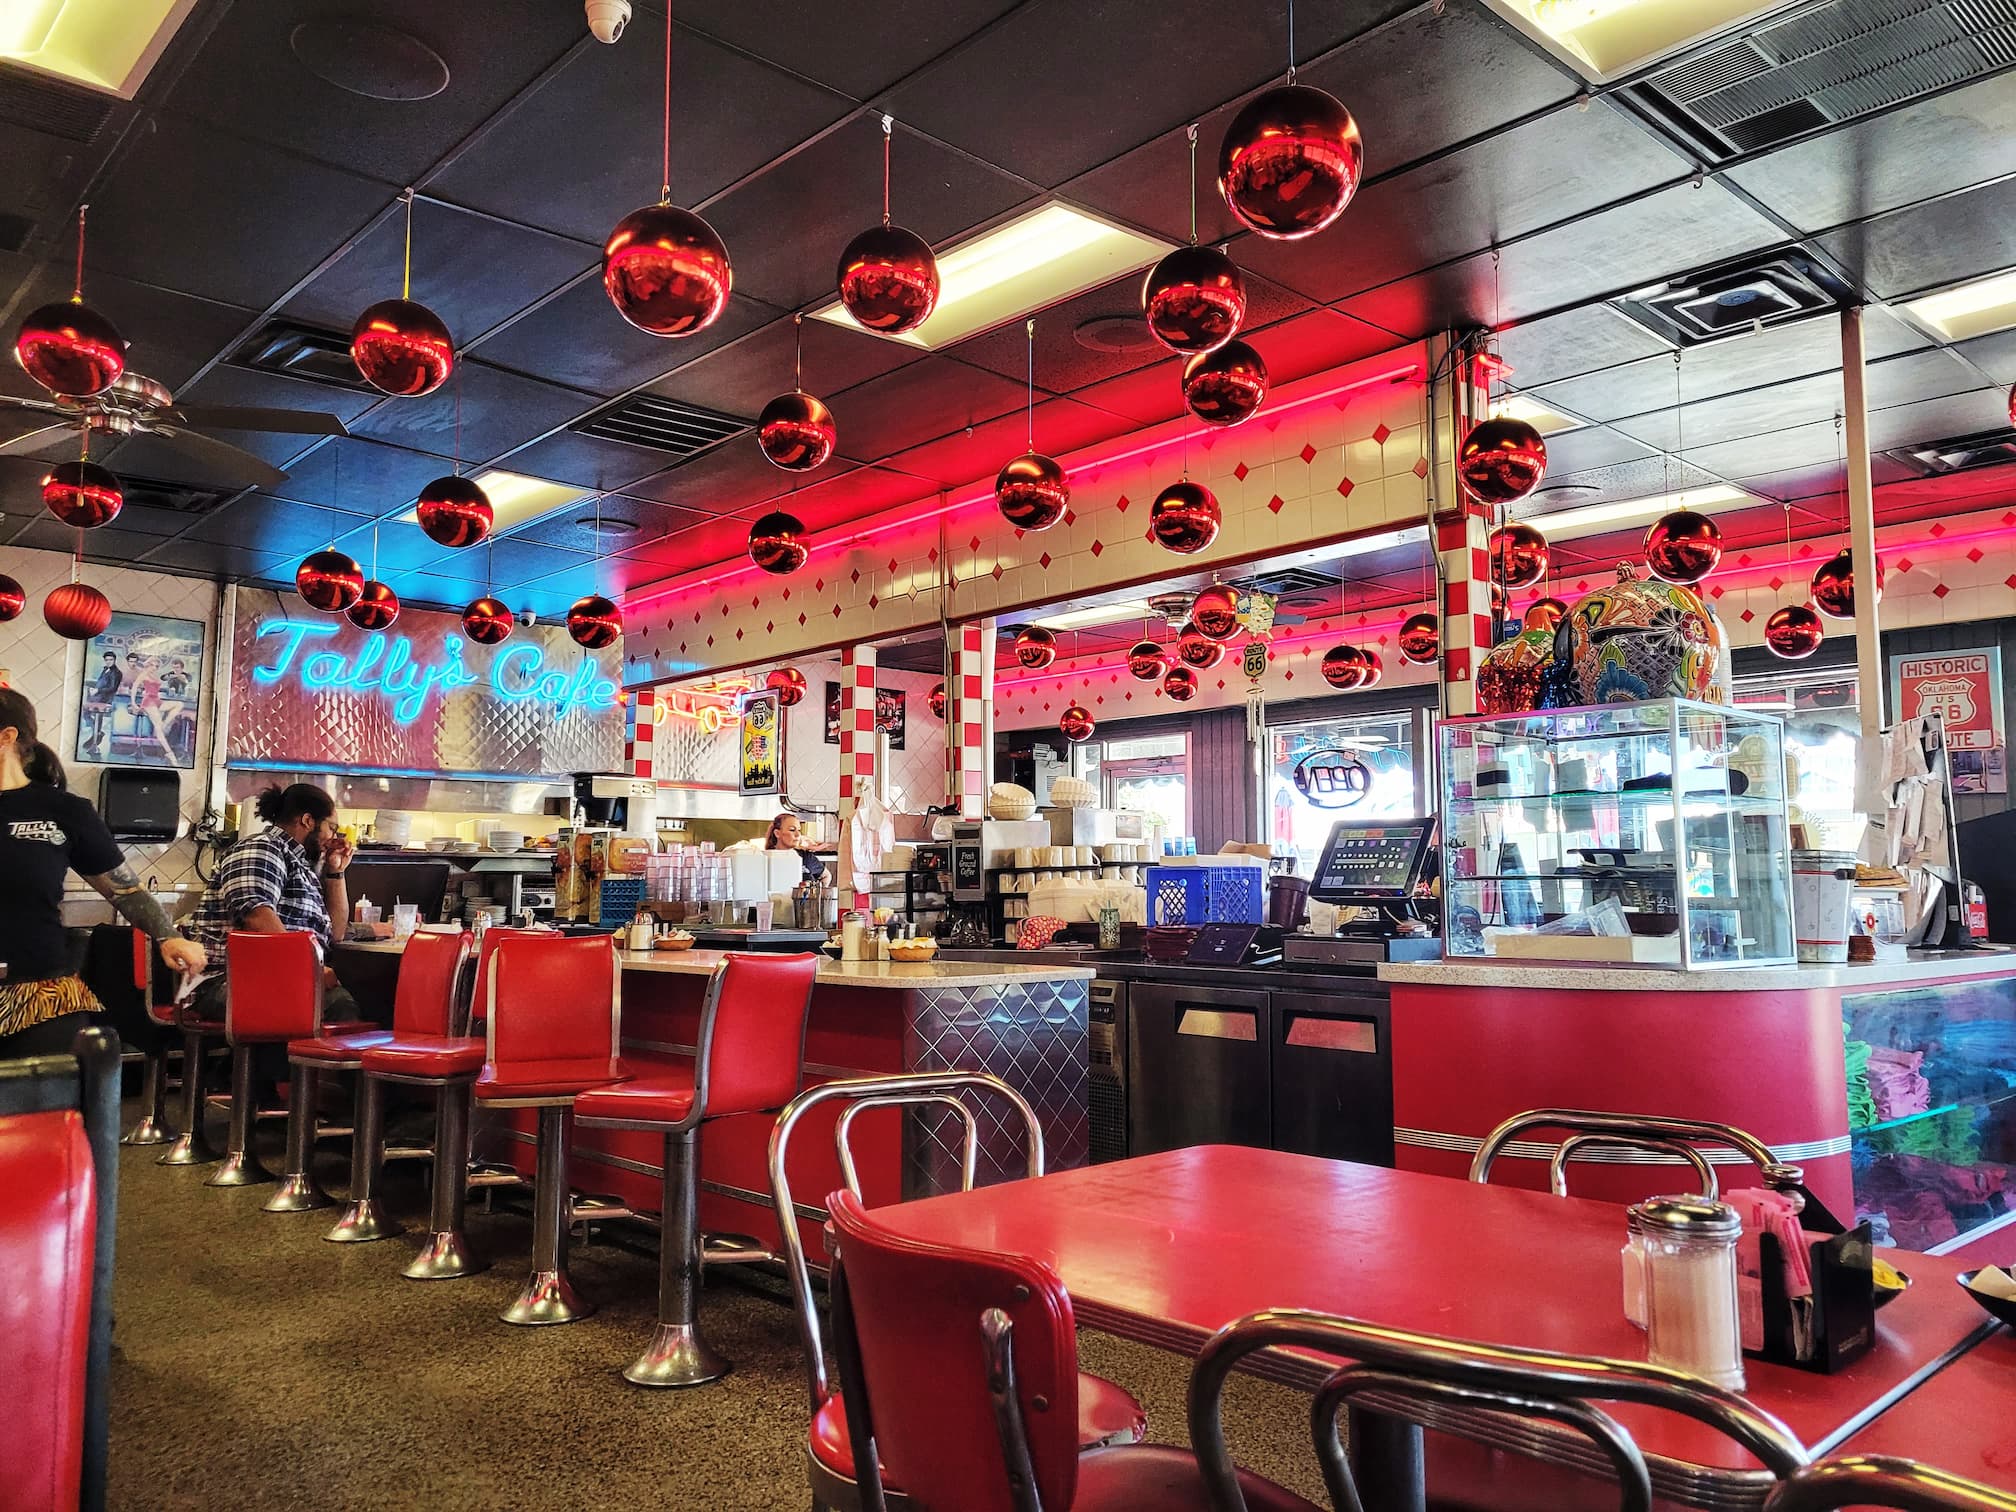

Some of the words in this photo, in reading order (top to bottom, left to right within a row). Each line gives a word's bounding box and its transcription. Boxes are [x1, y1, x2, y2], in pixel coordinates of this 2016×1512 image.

[253, 619, 479, 724] Tally's
[493, 644, 619, 721] Cafe
[1247, 656, 1262, 671] 66
[1906, 658, 1981, 676] HISTORIC
[1922, 684, 1967, 693] OKLAHOMA
